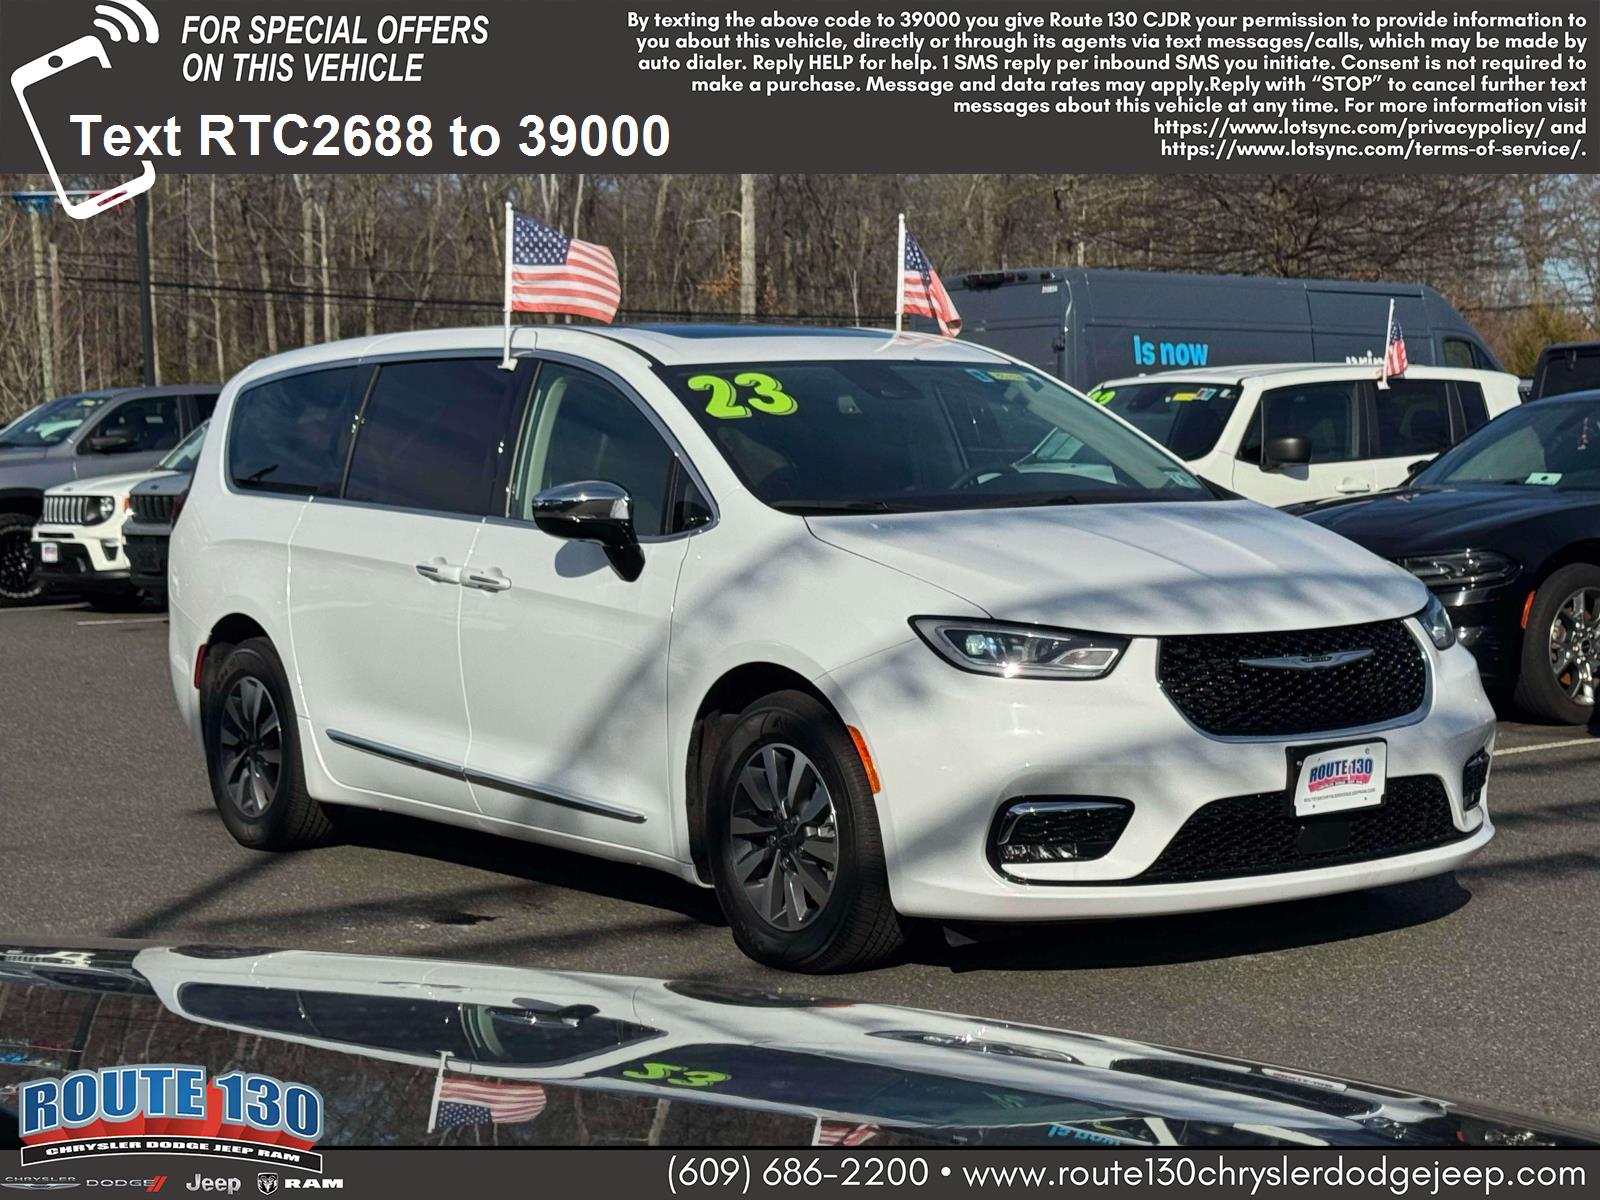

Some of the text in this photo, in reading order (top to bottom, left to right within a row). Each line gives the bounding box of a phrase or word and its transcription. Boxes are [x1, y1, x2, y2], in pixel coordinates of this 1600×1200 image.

[1133, 335, 1209, 366] Is now
[687, 371, 799, 420] 23
[1309, 757, 1374, 783] ROUTE 130
